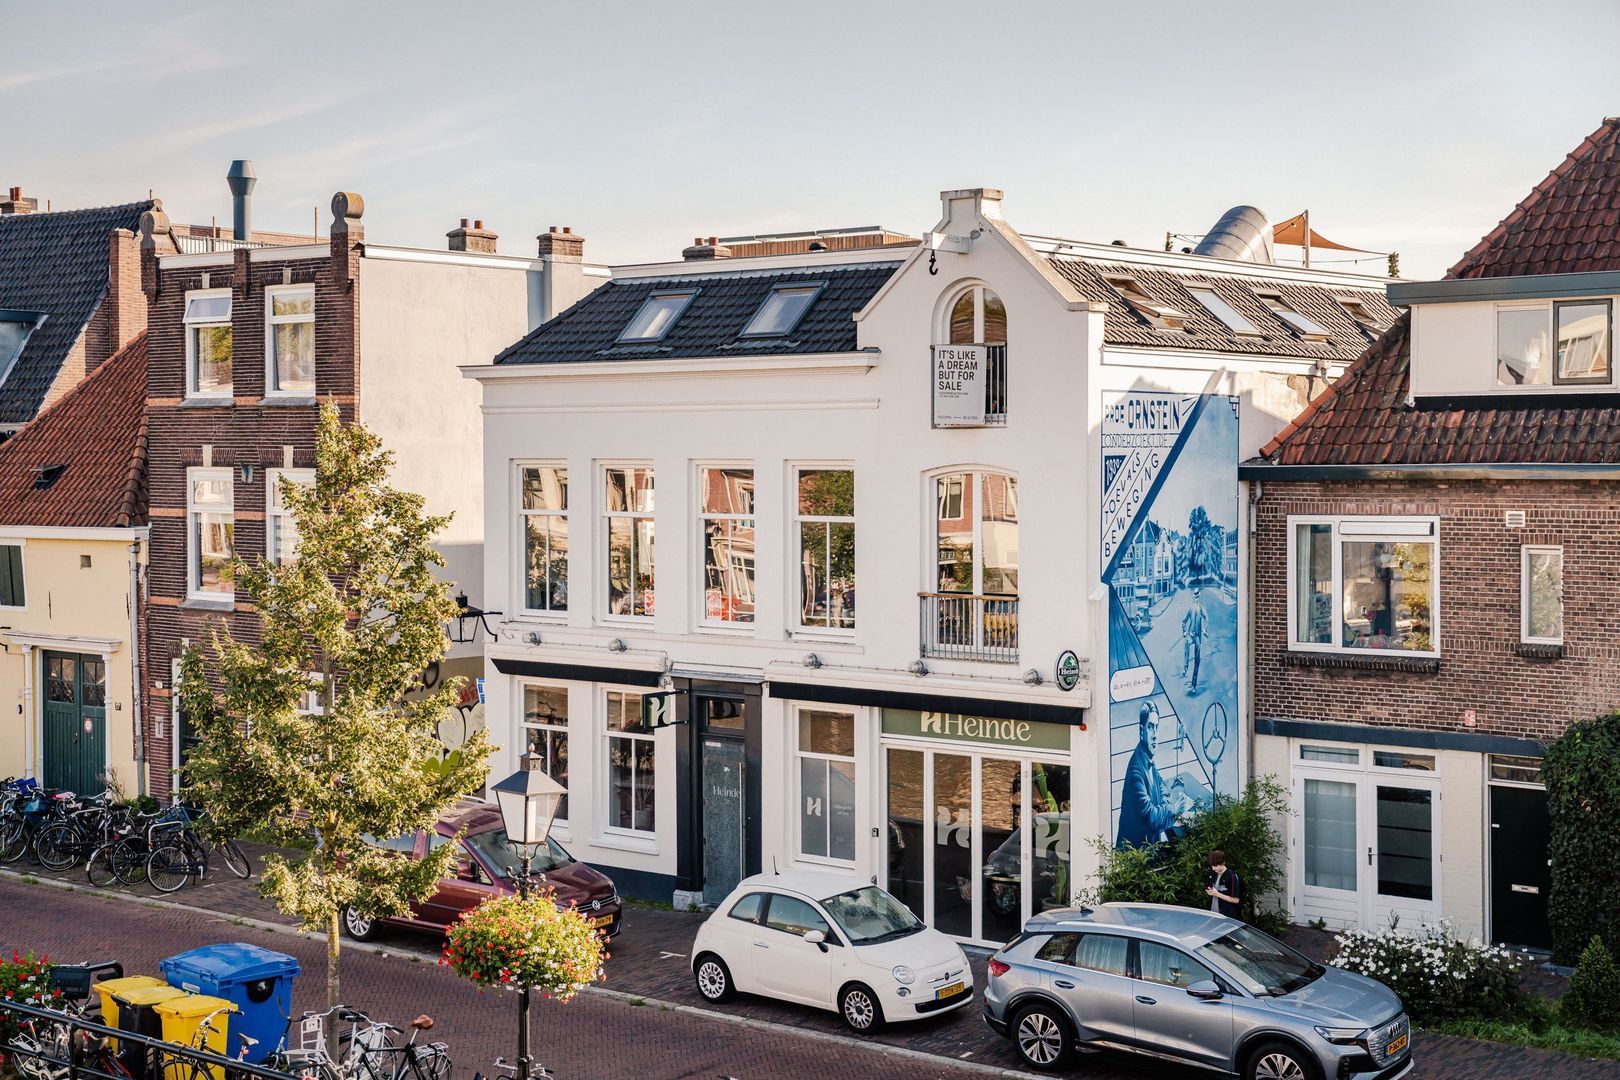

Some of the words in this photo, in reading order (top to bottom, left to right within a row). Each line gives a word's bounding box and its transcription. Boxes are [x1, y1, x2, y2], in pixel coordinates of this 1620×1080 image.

[938, 350, 955, 360] IT'S
[957, 350, 976, 360] LIKE
[938, 360, 945, 370] A
[947, 361, 978, 370] DREAM
[938, 370, 955, 380] BUT
[957, 371, 974, 380] FOR
[938, 381, 962, 391] SALE
[1127, 399, 1180, 430] ORNSTEIN
[943, 712, 1032, 742] Heinde
